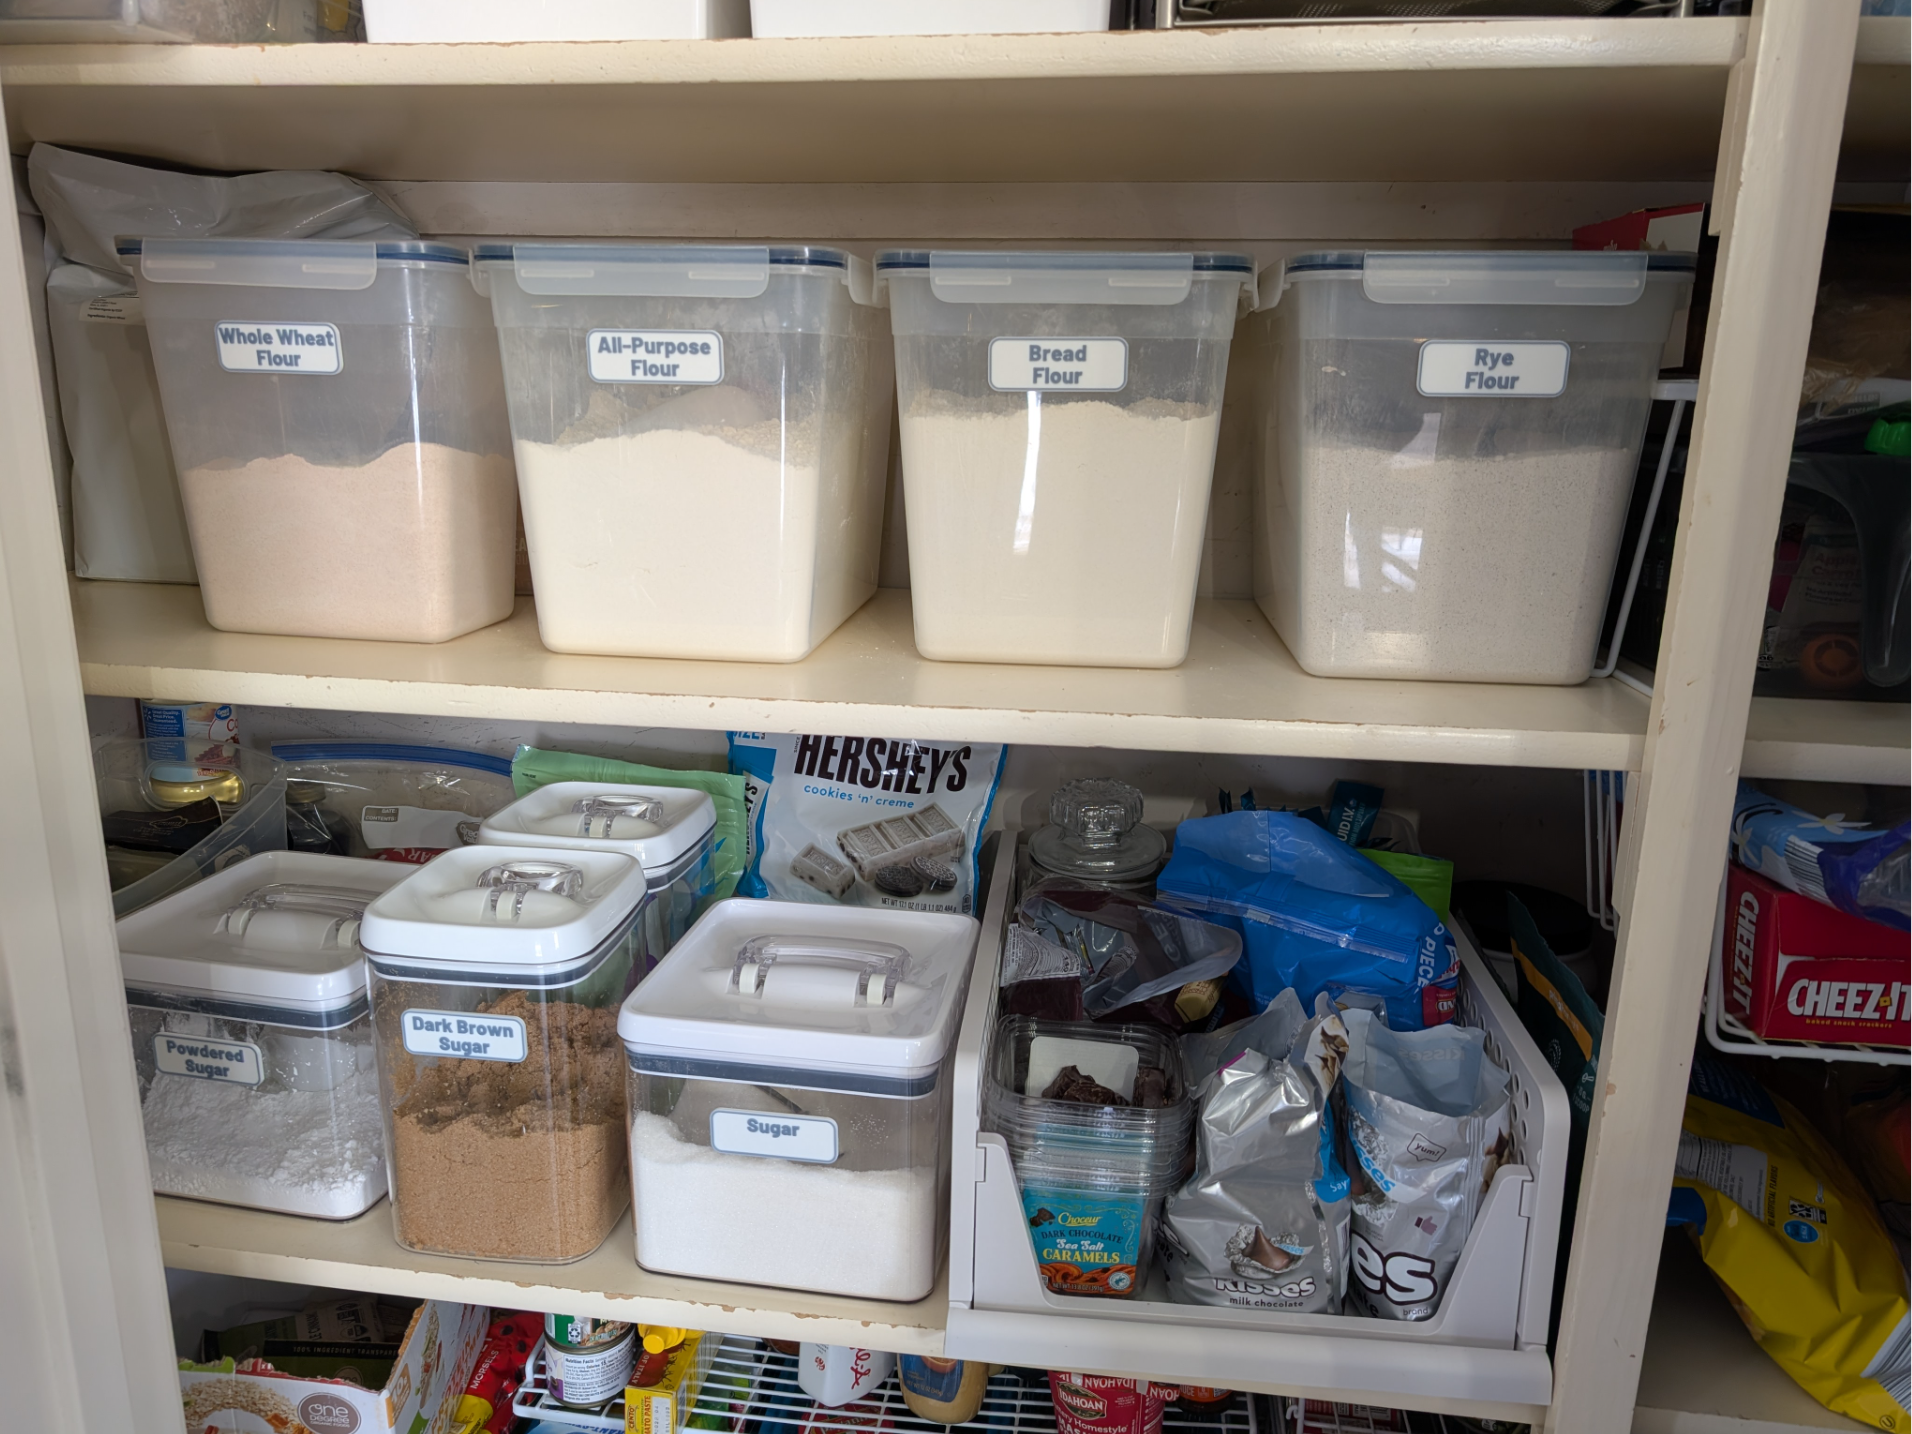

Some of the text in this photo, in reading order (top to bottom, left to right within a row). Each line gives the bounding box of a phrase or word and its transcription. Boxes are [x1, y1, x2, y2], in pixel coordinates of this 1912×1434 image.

[218, 328, 335, 346] Whole Wheat
[597, 336, 711, 359] All-Purpose
[1029, 344, 1087, 362] Bread
[256, 349, 301, 367] Flour
[1474, 348, 1515, 371] Rye
[630, 359, 680, 377] Flour
[1032, 367, 1083, 384] Flour
[1464, 371, 1520, 390] Flour
[794, 734, 972, 795] HERSHEY'S
[803, 784, 853, 801] cookies
[875, 797, 915, 809] creme
[460, 824, 479, 839] Grea
[1337, 821, 1351, 841] UID
[882, 897, 890, 905] NET
[890, 898, 898, 906] WT
[1415, 936, 1437, 989] PIECE
[412, 1016, 514, 1038] Dark Brown
[1806, 1018, 1893, 1028] baked snack crackers
[166, 1040, 245, 1063] Powdered
[439, 1036, 490, 1056] Sugar
[185, 1058, 230, 1078] Sugar
[746, 1118, 800, 1138] Sugar
[1414, 1142, 1440, 1157] yum!
[1330, 1178, 1348, 1193] Say
[1767, 1190, 1777, 1219] ARTIFICIAL
[1057, 1212, 1103, 1227] Choceur
[1041, 1229, 1124, 1244] DARK CHOCOLATE
[1056, 1238, 1105, 1251] Sea Salt
[1042, 1248, 1120, 1264] CARAMELS
[1229, 1296, 1304, 1308] milk chocolate
[1403, 1307, 1429, 1316] brand
[313, 1346, 355, 1355] INGREDIENT
[357, 1348, 398, 1356] TRANSPARE
[470, 1350, 499, 1390] MORSELS
[631, 1354, 650, 1384] OF ITALY
[1059, 1388, 1104, 1411] IDAHOAN
[1150, 1386, 1180, 1401] HOAN
[628, 1407, 636, 1429] CENTO
[643, 1395, 652, 1434] PASTE MATO
[1074, 1418, 1127, 1434] Homestyle
